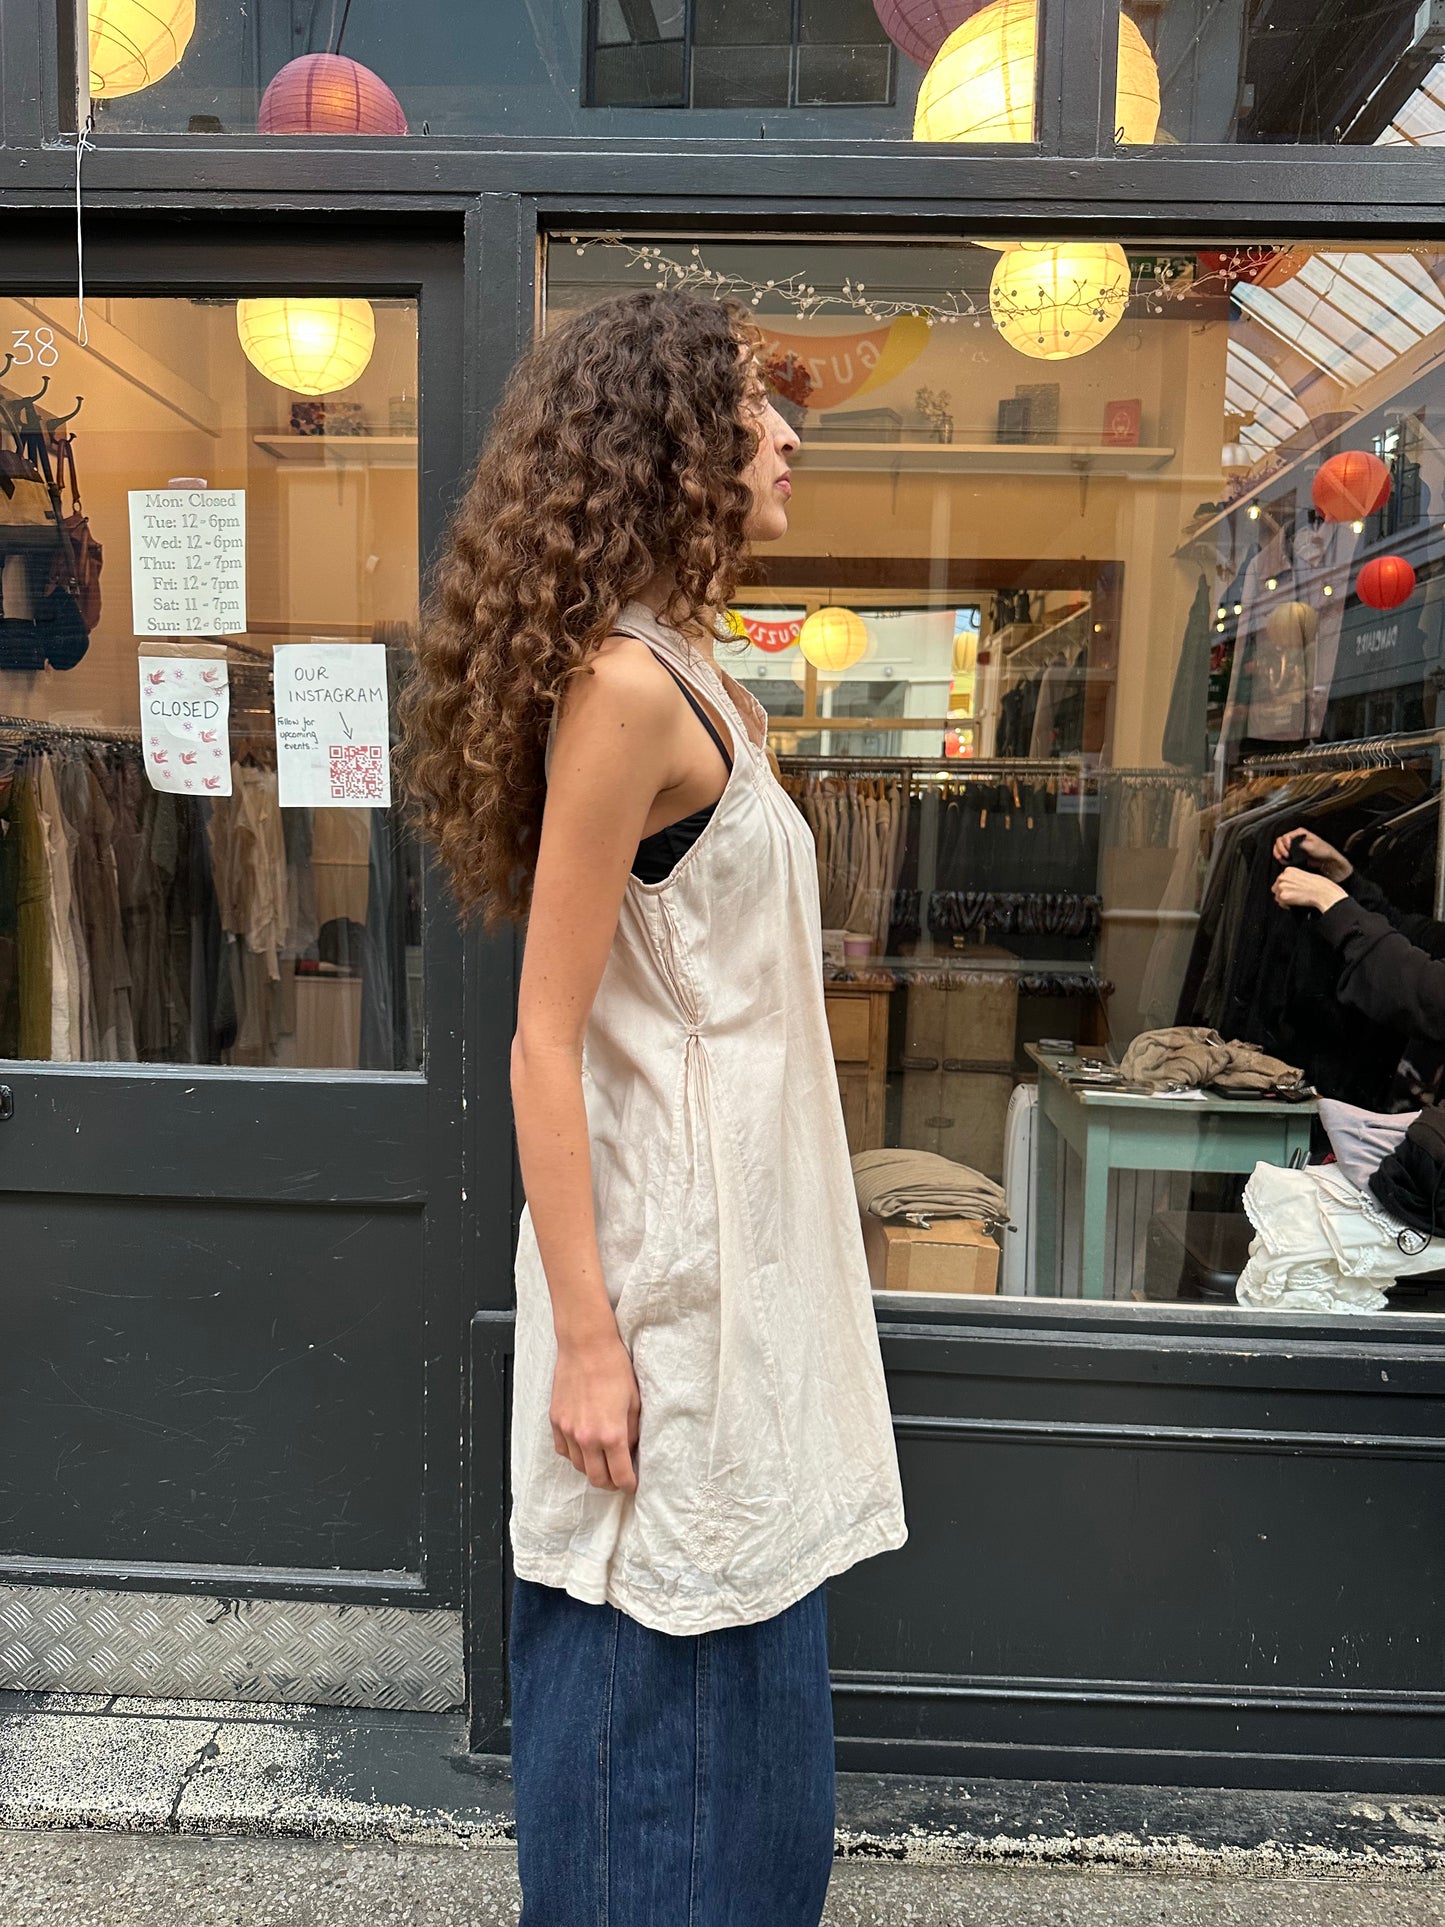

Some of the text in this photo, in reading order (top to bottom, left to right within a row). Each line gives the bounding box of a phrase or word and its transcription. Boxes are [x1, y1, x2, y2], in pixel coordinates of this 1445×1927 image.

[11, 327, 59, 367] 38
[145, 493, 236, 508] Mon: Closed
[143, 515, 177, 528] Tue:
[141, 535, 182, 549] Wed:
[139, 556, 176, 570] Thu:
[152, 576, 178, 590] Fri:
[153, 597, 180, 611] Sat:
[147, 617, 180, 631] Sun:
[294, 666, 329, 681] OUR
[288, 687, 383, 703] INSTAGRAM
[150, 700, 219, 719] CLOSED
[277, 716, 315, 732] Follow for
[279, 731, 319, 744] upcoming
